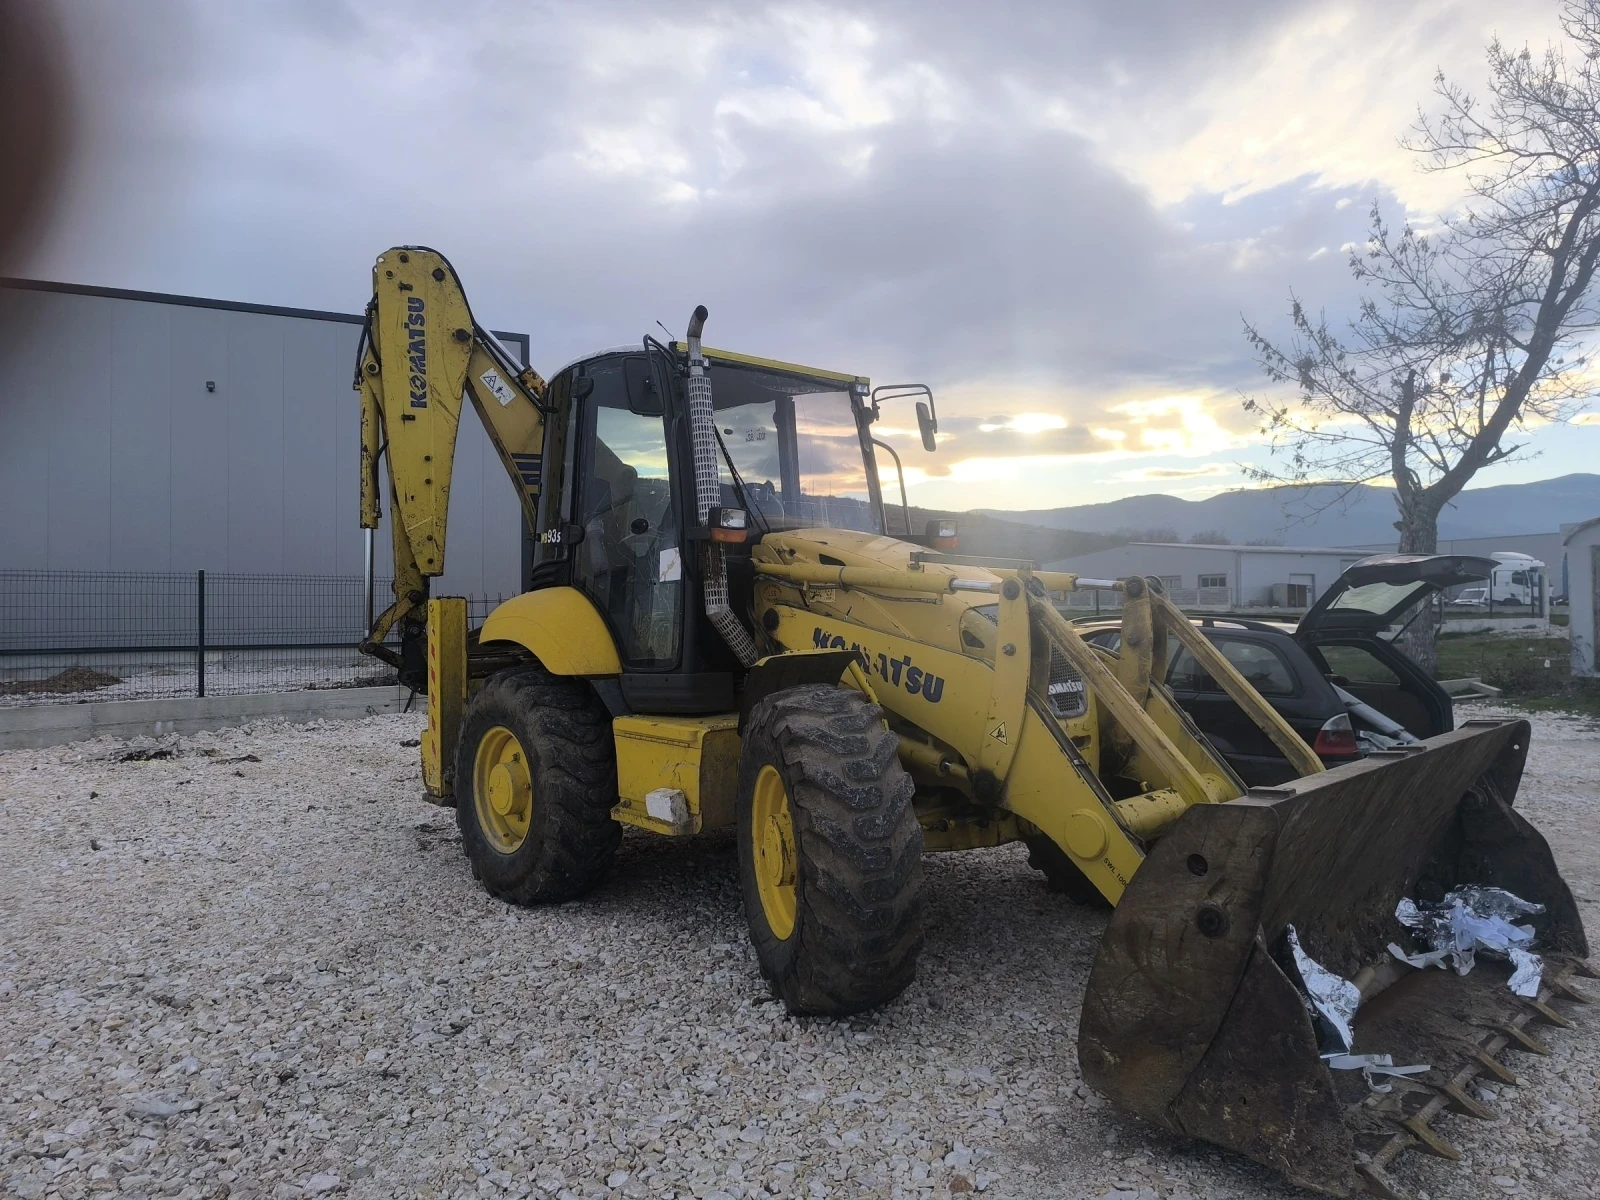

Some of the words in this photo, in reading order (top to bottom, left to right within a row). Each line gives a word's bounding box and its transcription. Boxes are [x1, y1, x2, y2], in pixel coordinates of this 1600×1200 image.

[403, 296, 427, 408] KOMATSU
[1048, 679, 1083, 695] OMATSU
[1103, 857, 1116, 874] SWL
